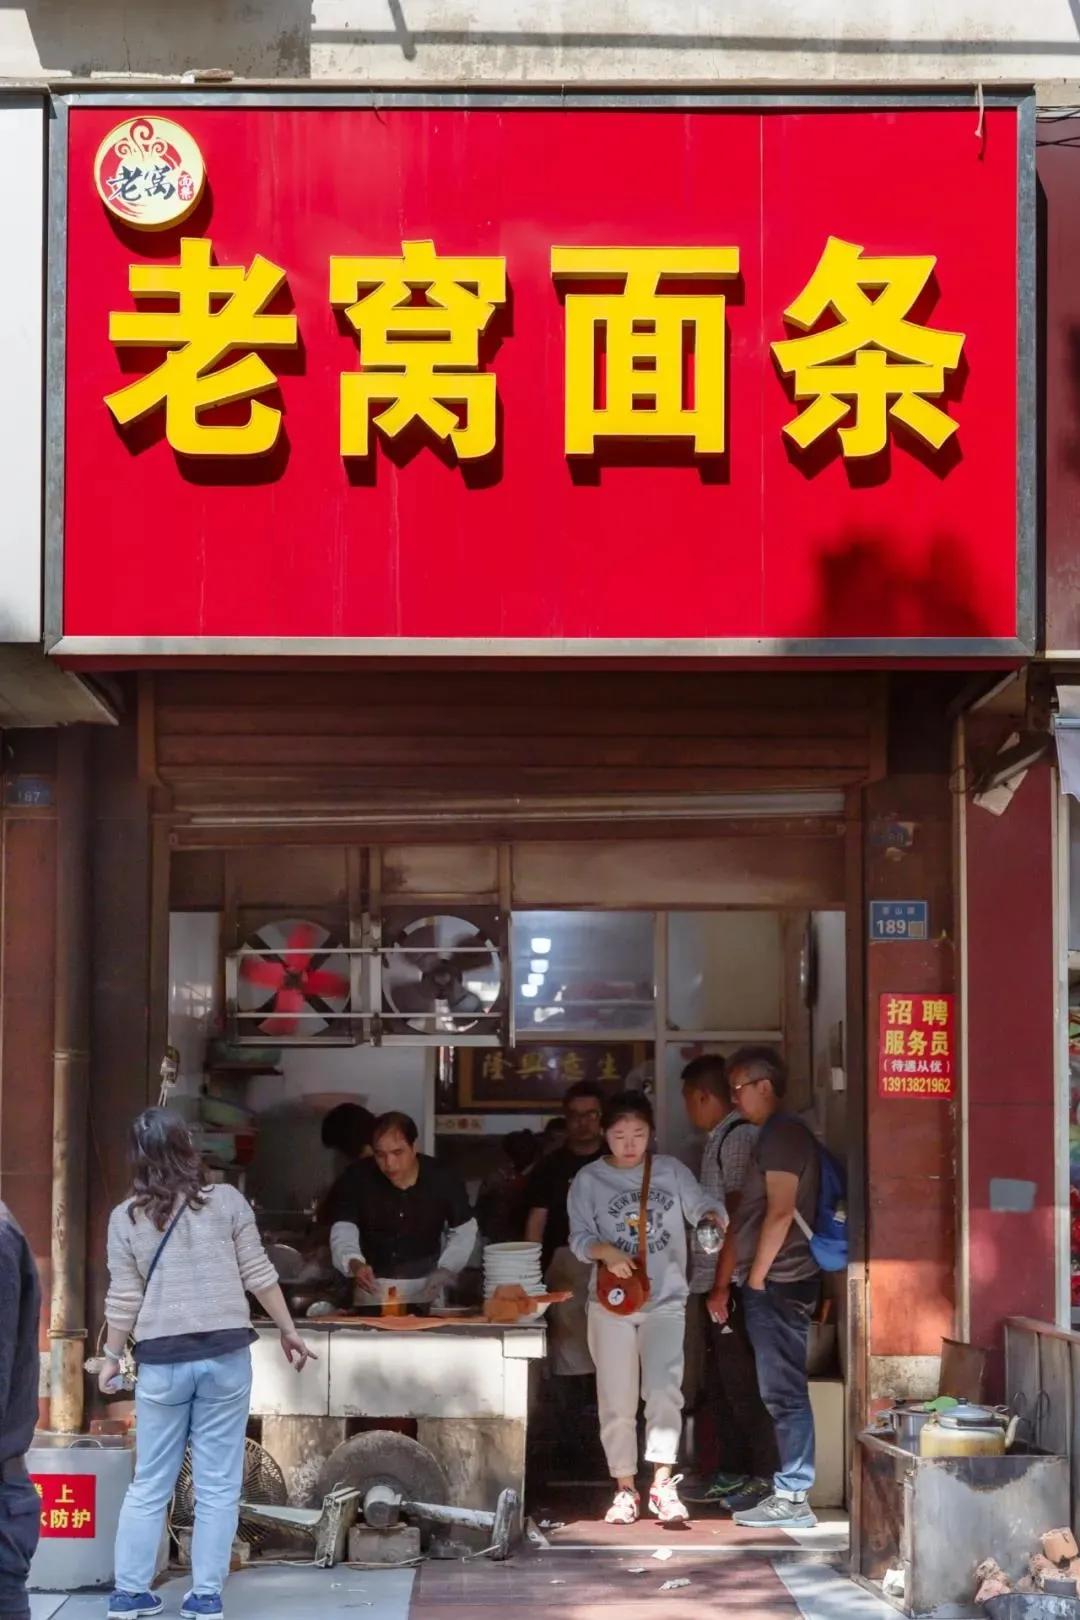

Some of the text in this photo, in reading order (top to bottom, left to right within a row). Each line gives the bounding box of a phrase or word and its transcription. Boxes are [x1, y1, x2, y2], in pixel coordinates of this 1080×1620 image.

[105, 165, 176, 201] 老窝
[104, 236, 966, 461] 老窝面条
[876, 919, 906, 935] 189
[887, 998, 948, 1025] 招聘
[884, 1030, 949, 1056] 服务员
[882, 1076, 951, 1093] 13913821962
[608, 1194, 630, 1218] NEW
